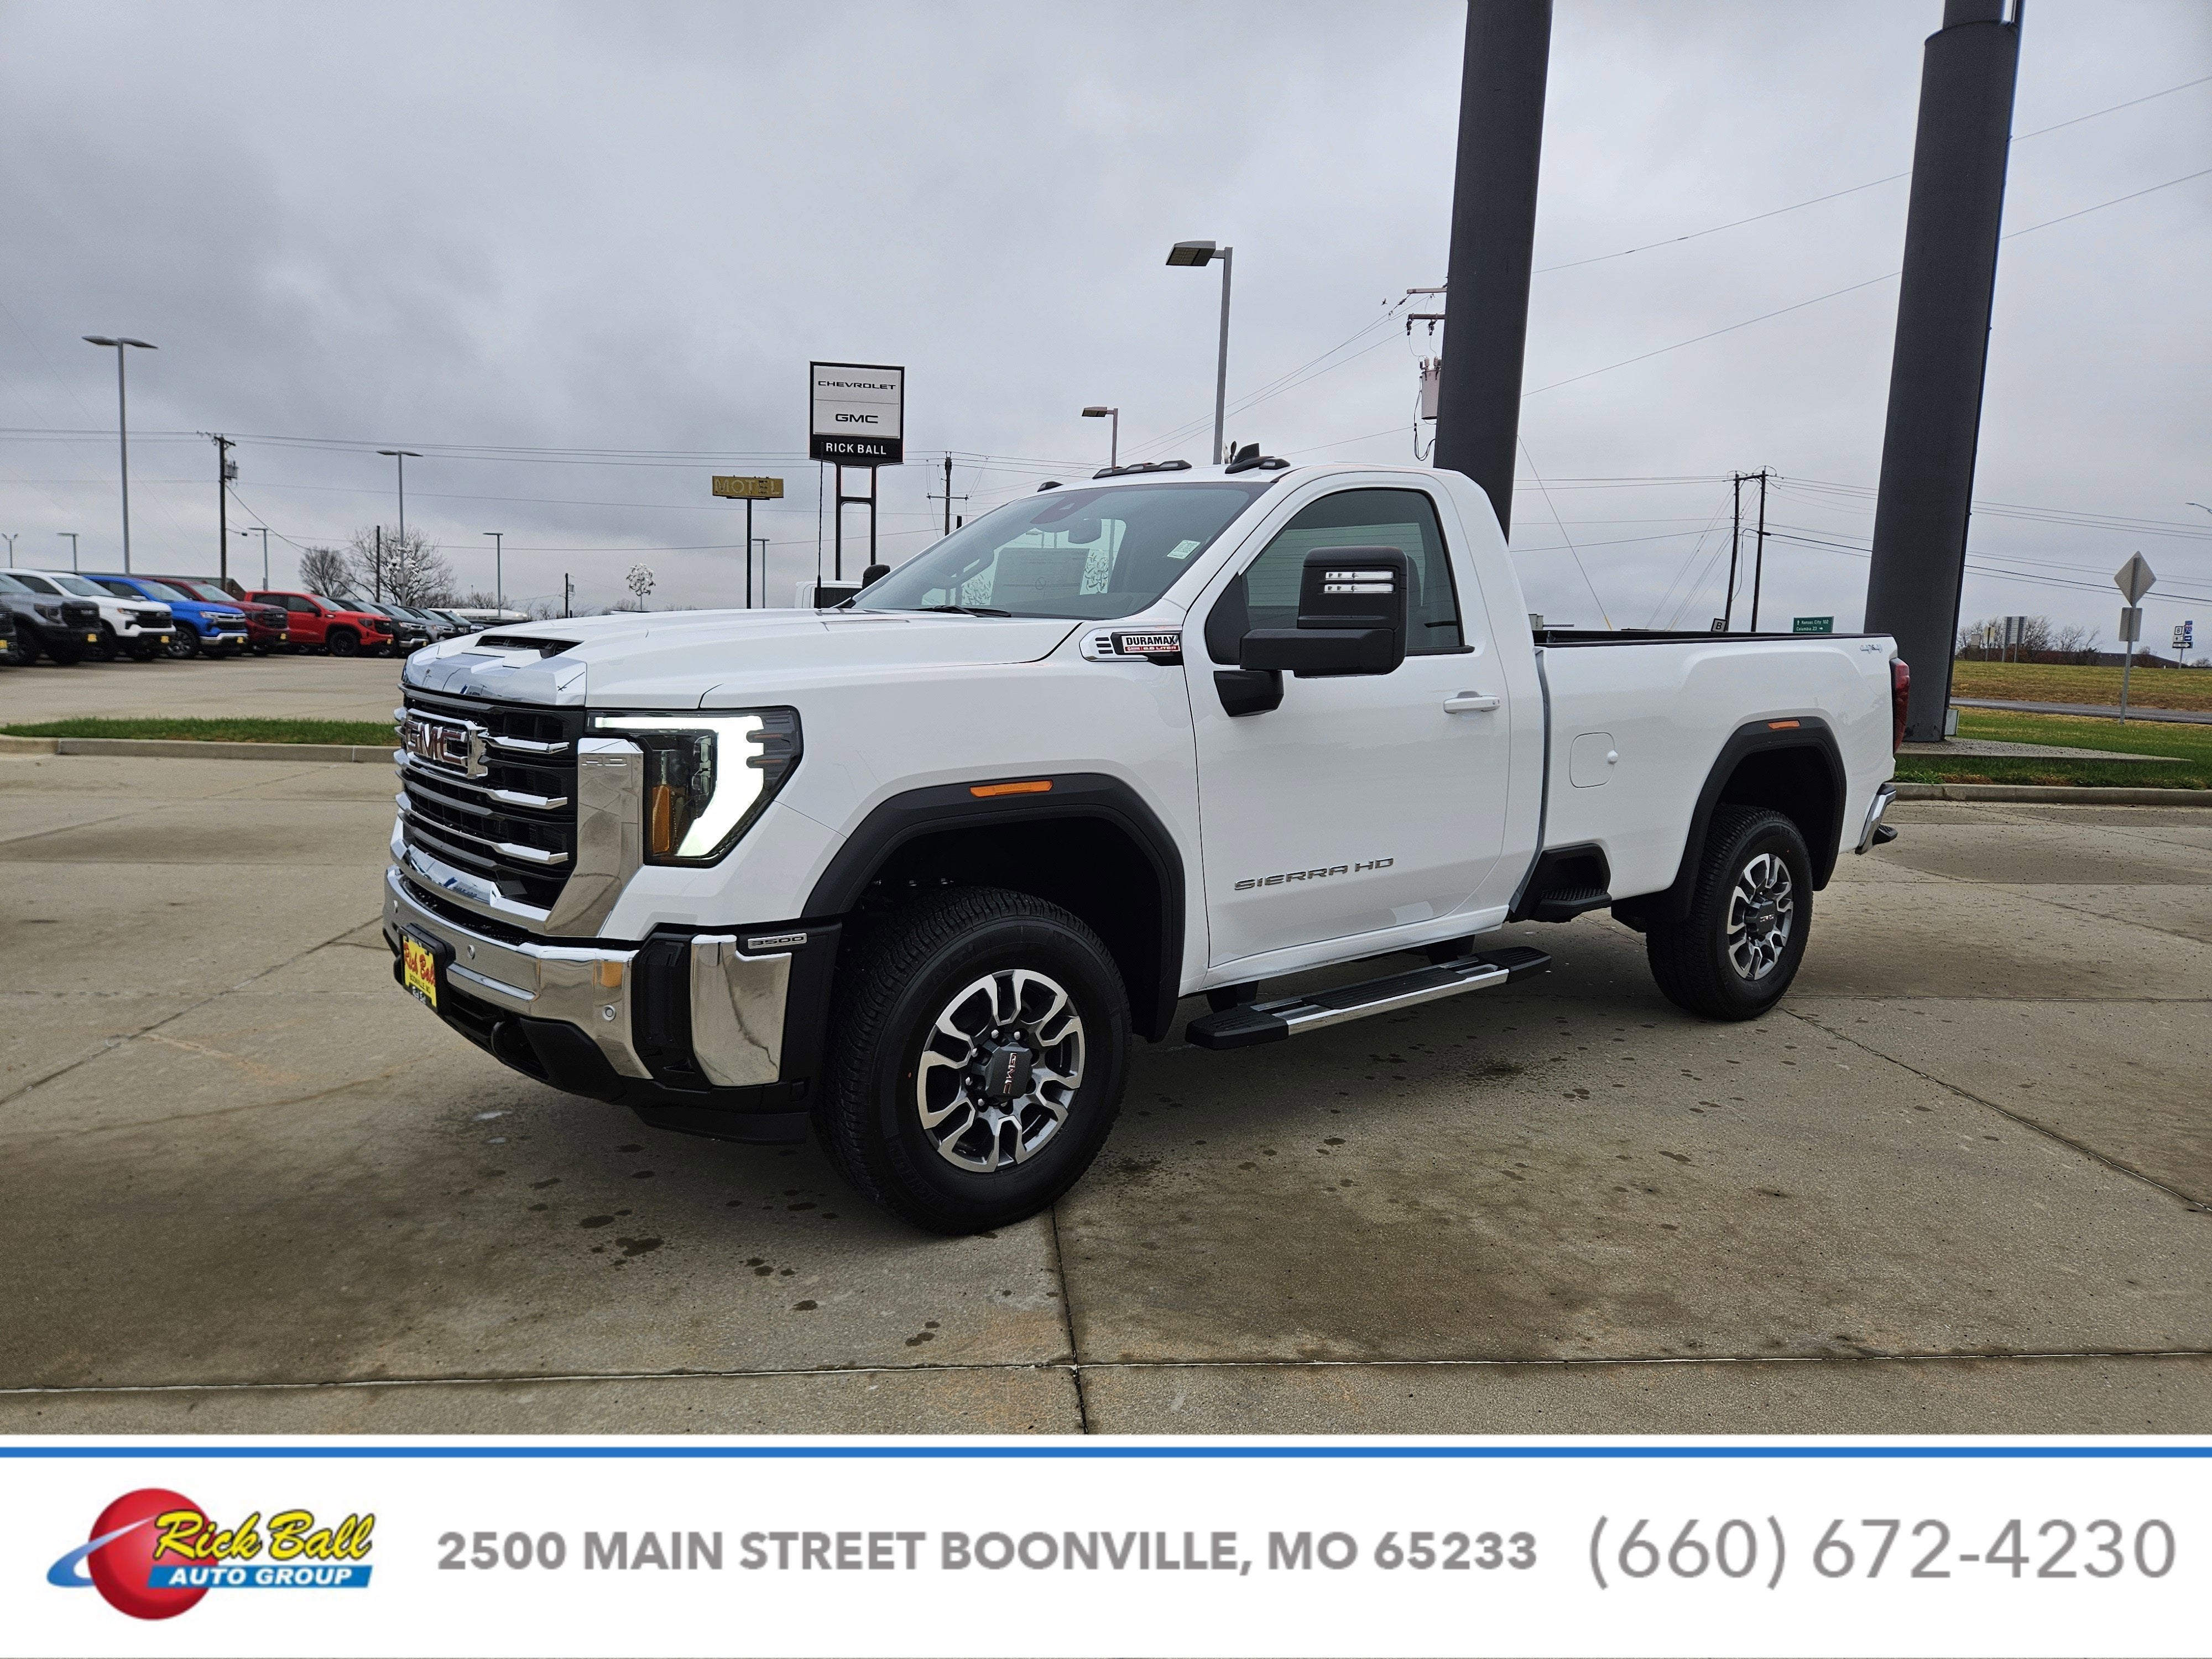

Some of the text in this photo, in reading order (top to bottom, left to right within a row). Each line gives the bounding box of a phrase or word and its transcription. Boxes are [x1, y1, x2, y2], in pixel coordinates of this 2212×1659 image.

[818, 380, 896, 390] CHEVROLET
[835, 414, 878, 424] GMC
[826, 442, 886, 455] RICK BALL
[714, 479, 780, 495] MOTEL
[1126, 636, 1178, 645] DURAMAX
[406, 719, 468, 768] GMC
[582, 757, 627, 766] HD
[1234, 857, 1394, 890] SIERRA HD
[752, 936, 804, 946] 3500
[1003, 1052, 1017, 1094] GMC
